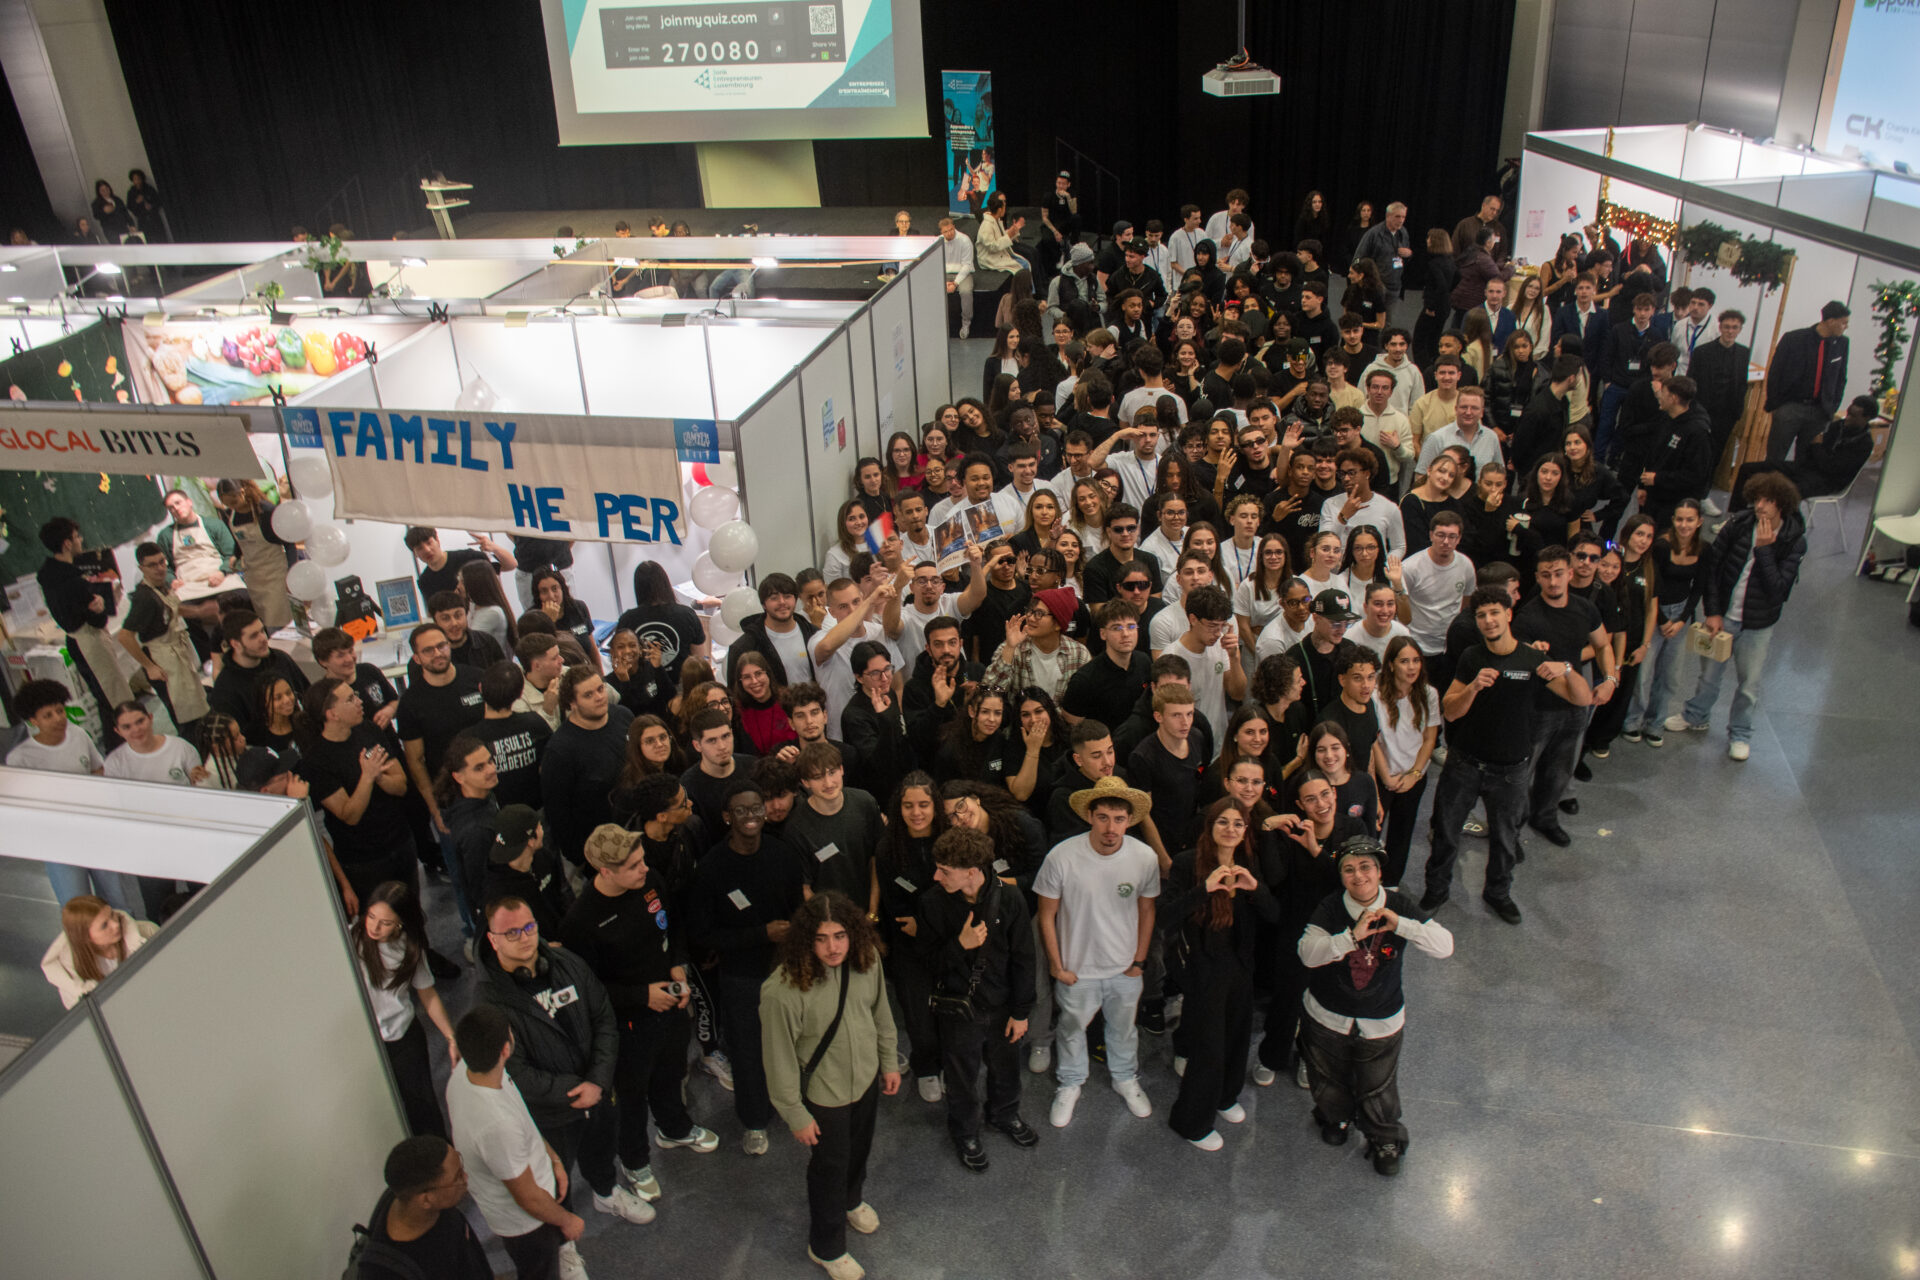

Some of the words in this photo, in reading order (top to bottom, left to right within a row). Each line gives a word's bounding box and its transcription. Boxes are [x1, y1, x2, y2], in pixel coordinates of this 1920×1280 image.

[661, 40, 759, 63] 270080
[327, 412, 517, 472] FAMILY
[594, 492, 682, 546] PER
[493, 731, 533, 755] RESULTS
[507, 747, 537, 772] DETECT
